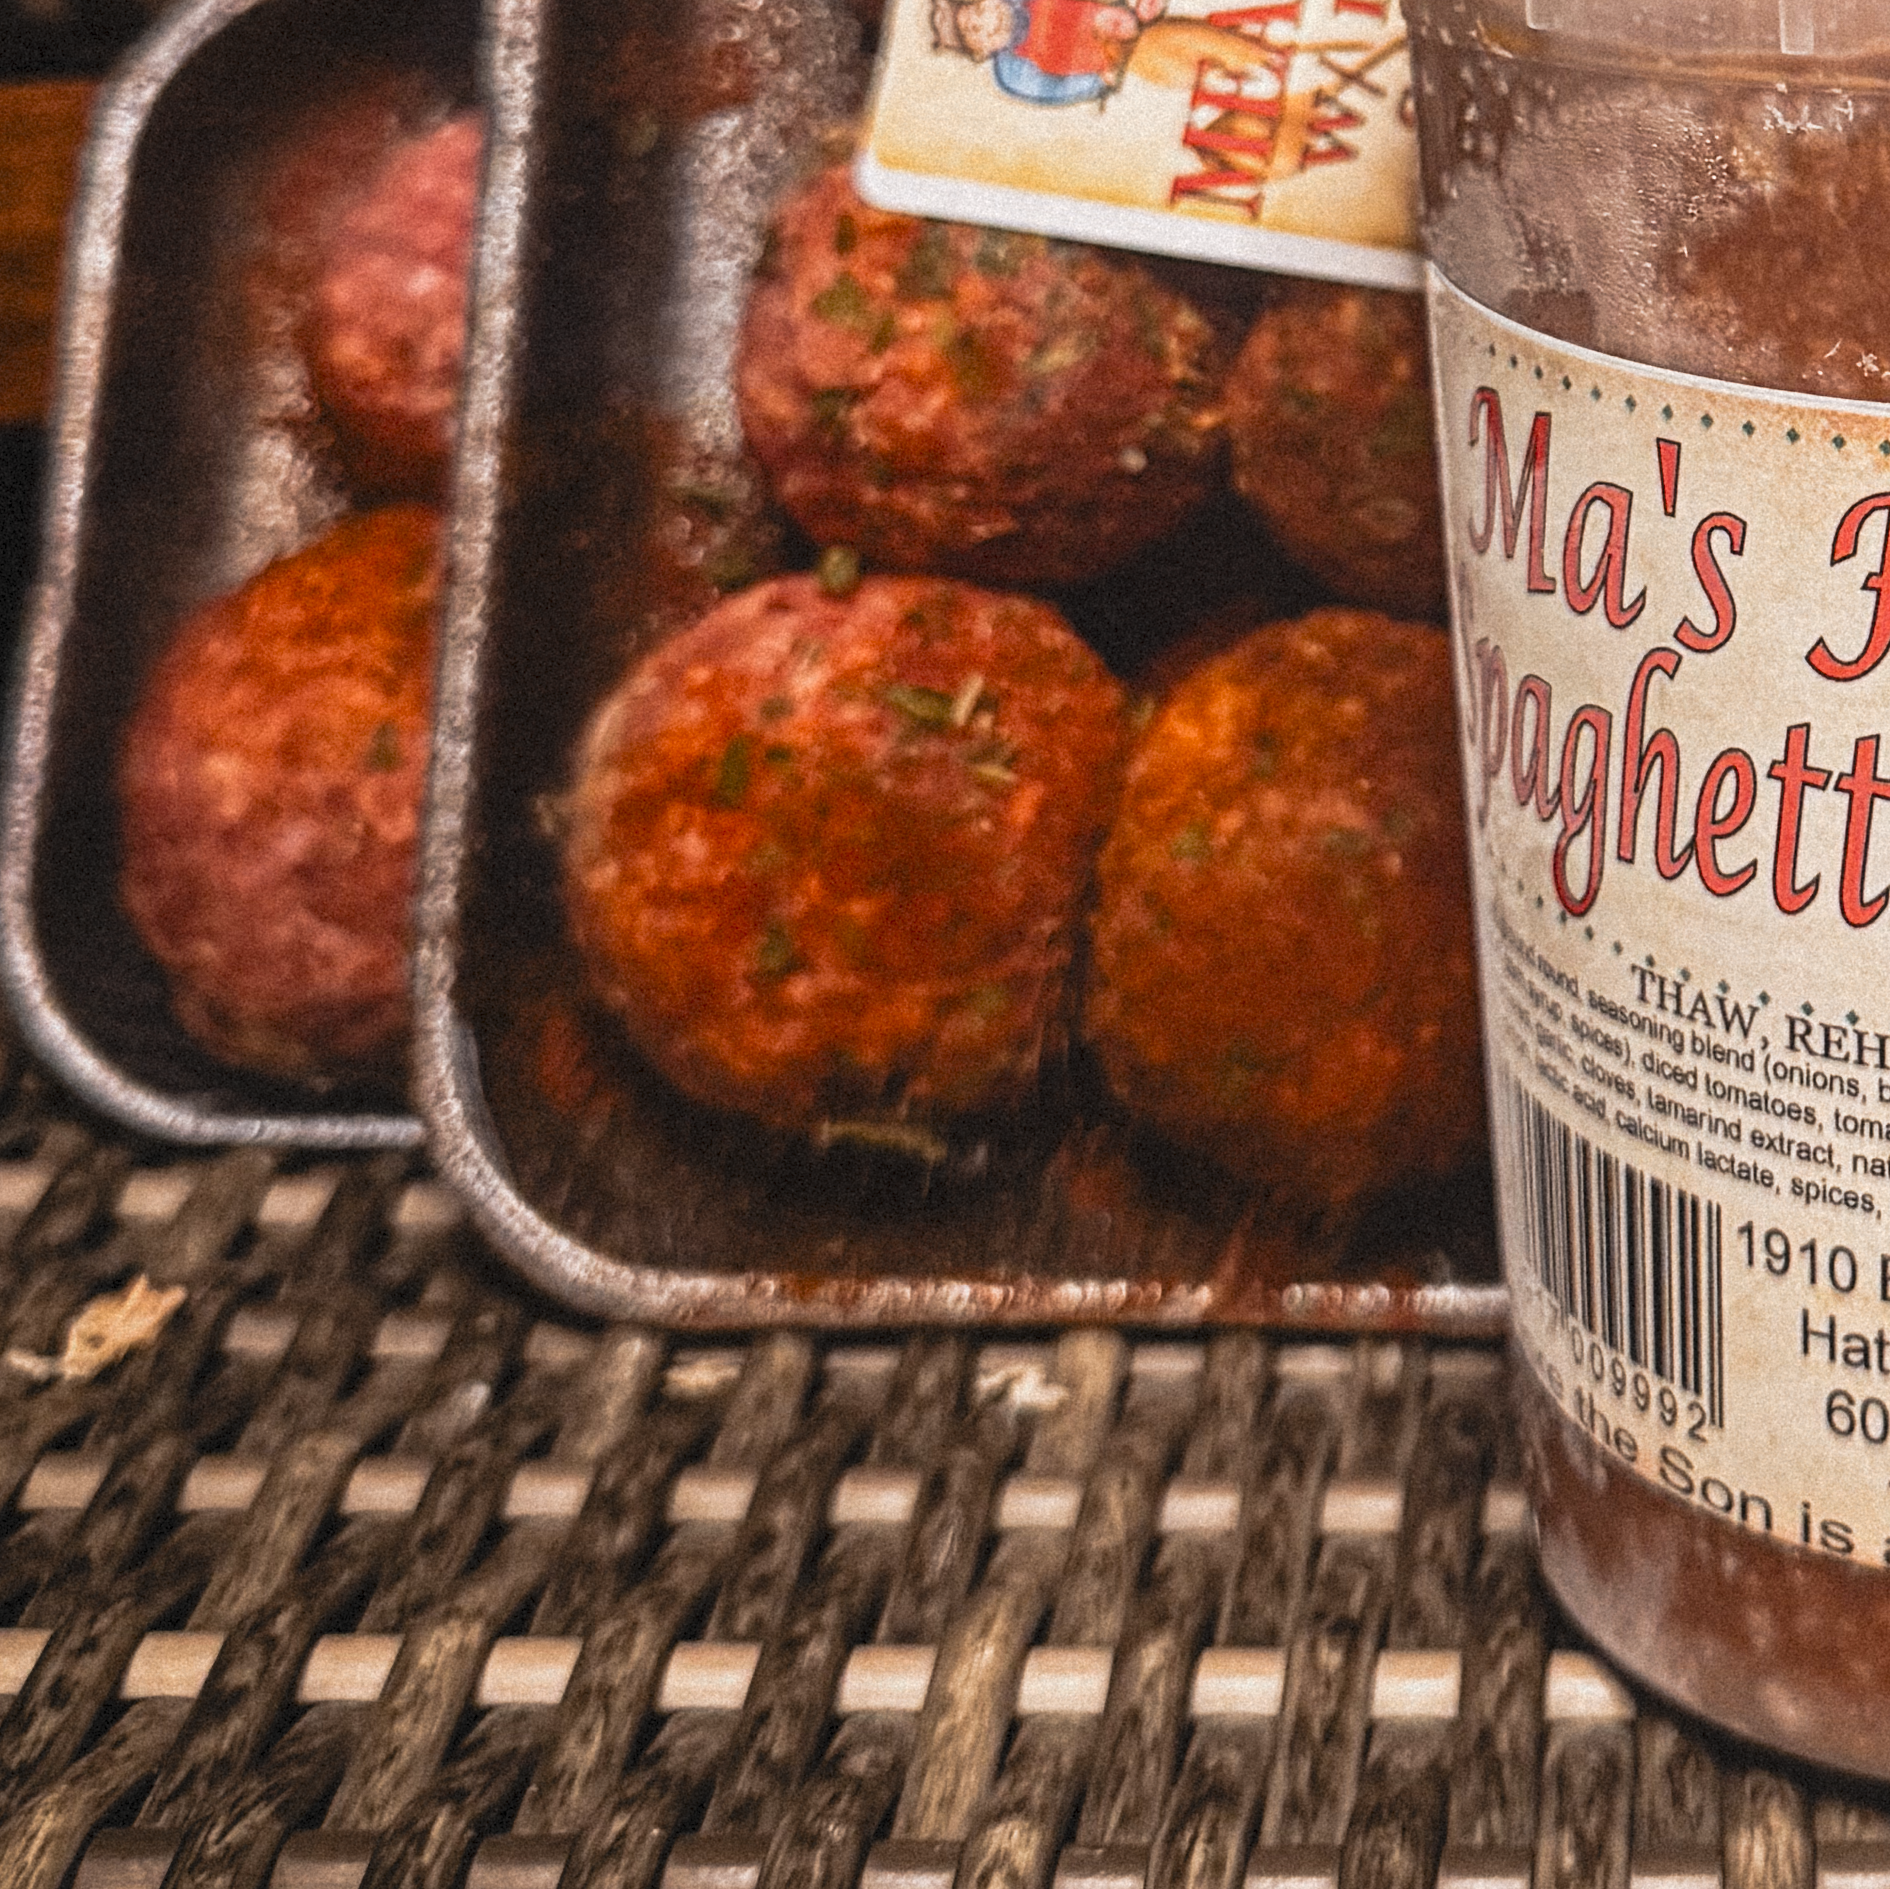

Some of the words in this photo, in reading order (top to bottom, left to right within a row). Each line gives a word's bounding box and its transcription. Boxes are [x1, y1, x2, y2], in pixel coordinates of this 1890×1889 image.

[1468, 386, 1747, 654] Ma's
[1588, 988, 1686, 1054] seasoning
[1690, 1029, 1756, 1073] blend
[1763, 1051, 1868, 1105] (onions,
[1630, 962, 1771, 1051] THAW,
[1640, 1048, 1698, 1092] diced
[1704, 1083, 1824, 1128] tomatoes,
[1646, 1084, 1743, 1143] tamarind
[1749, 1124, 1843, 1172] extract,
[1616, 1108, 1690, 1160] calcium
[1697, 1139, 1781, 1195] lactate,
[1790, 1173, 1883, 1220] spices,
[1737, 1220, 1859, 1296] 1910
[1659, 1443, 1774, 1532] Son
[1799, 1500, 1856, 1557] is
